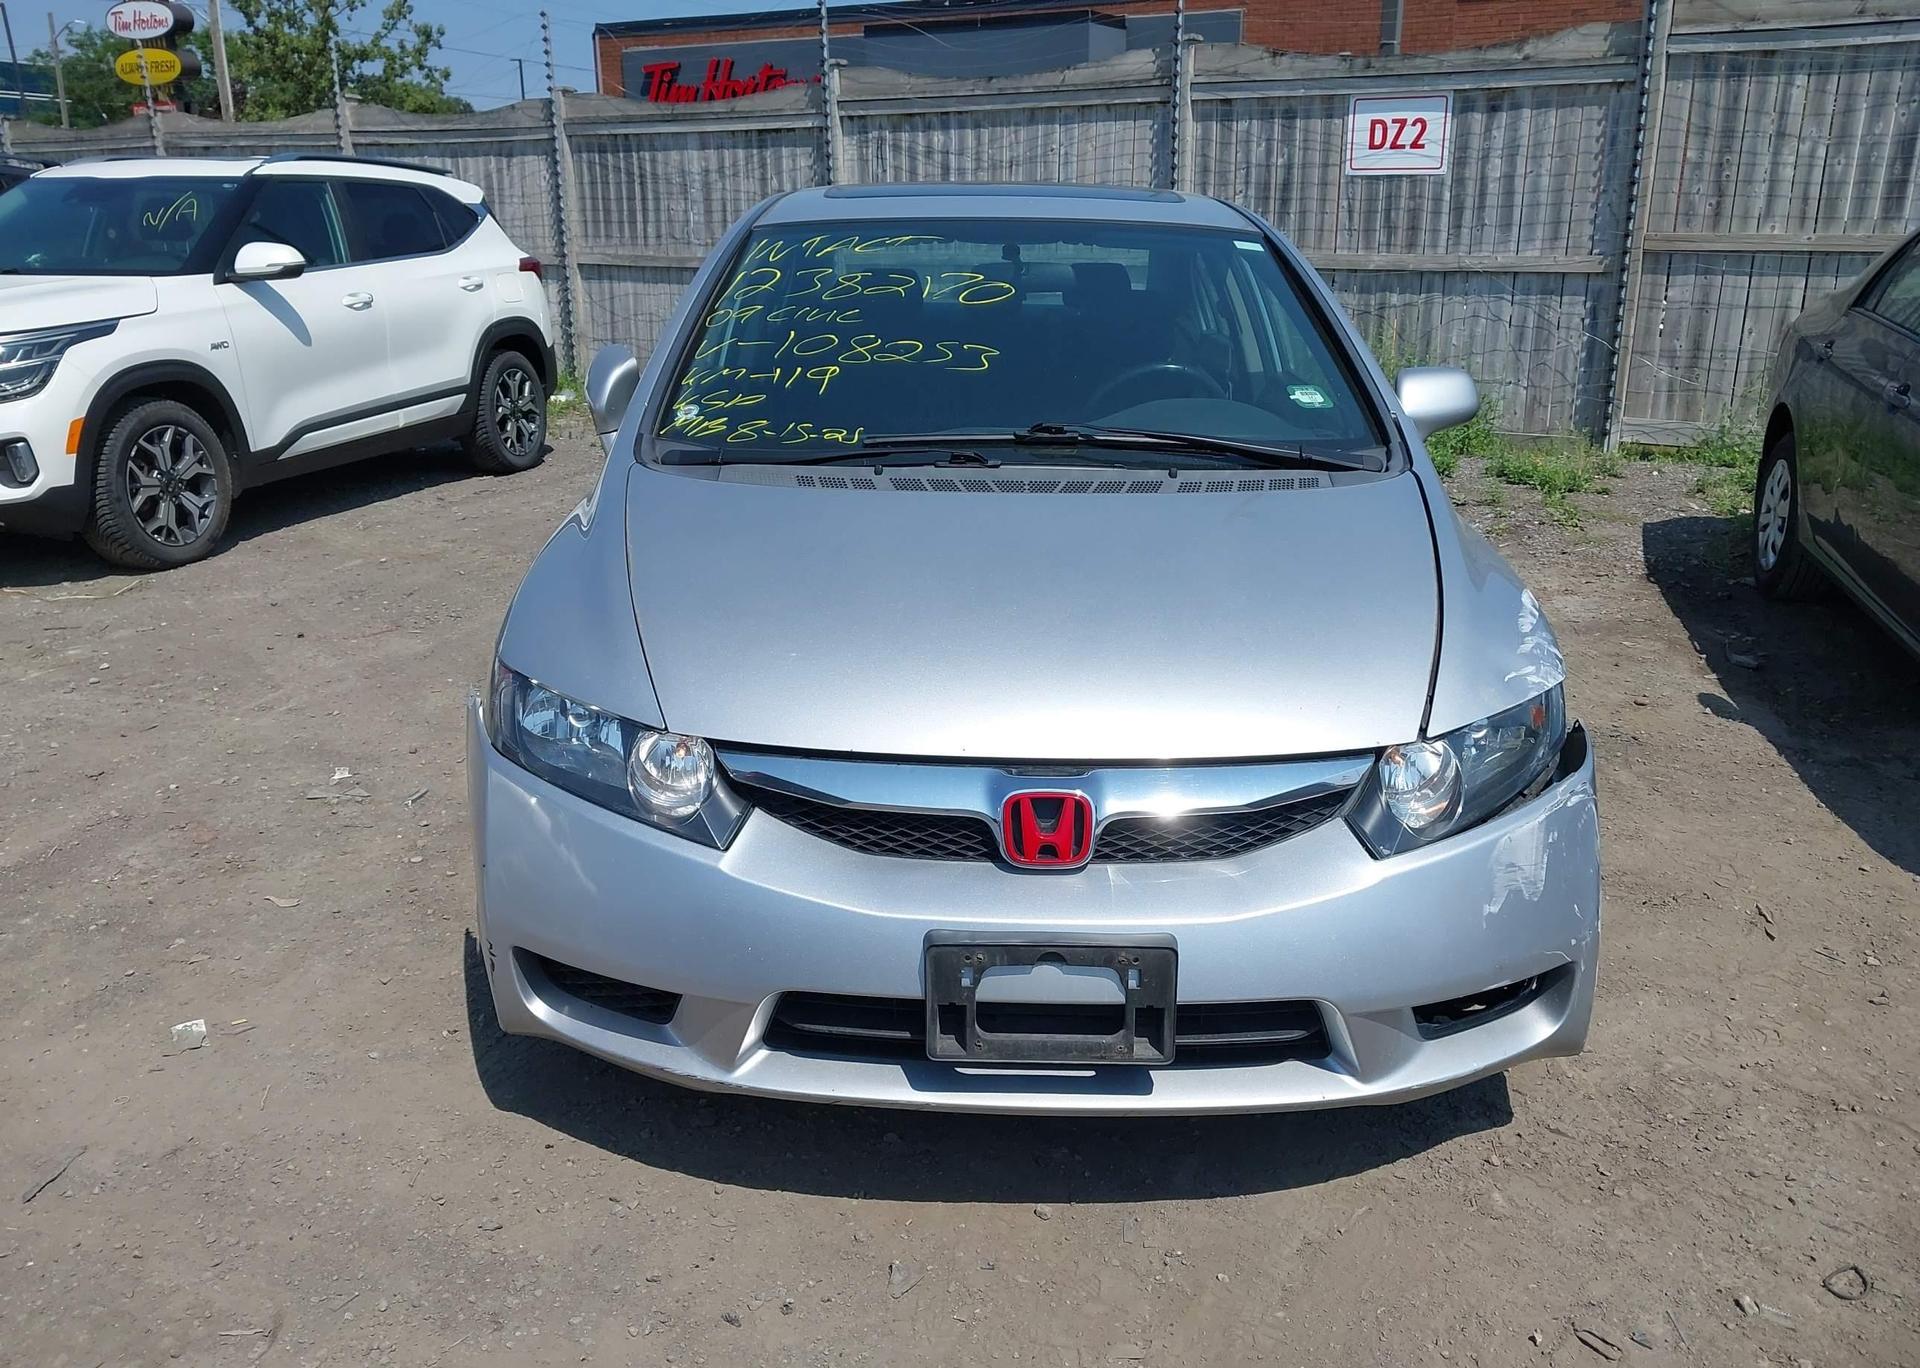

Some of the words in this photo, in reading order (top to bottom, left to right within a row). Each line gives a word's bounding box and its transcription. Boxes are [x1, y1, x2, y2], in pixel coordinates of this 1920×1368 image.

[111, 11, 132, 32] Tim
[133, 9, 169, 31] Hortons
[150, 60, 176, 73] FRESH
[641, 61, 698, 103] Tim
[702, 56, 822, 101] Horto
[1367, 117, 1428, 150] DZ2
[142, 190, 198, 232] N/A
[714, 268, 1016, 310] 12382170
